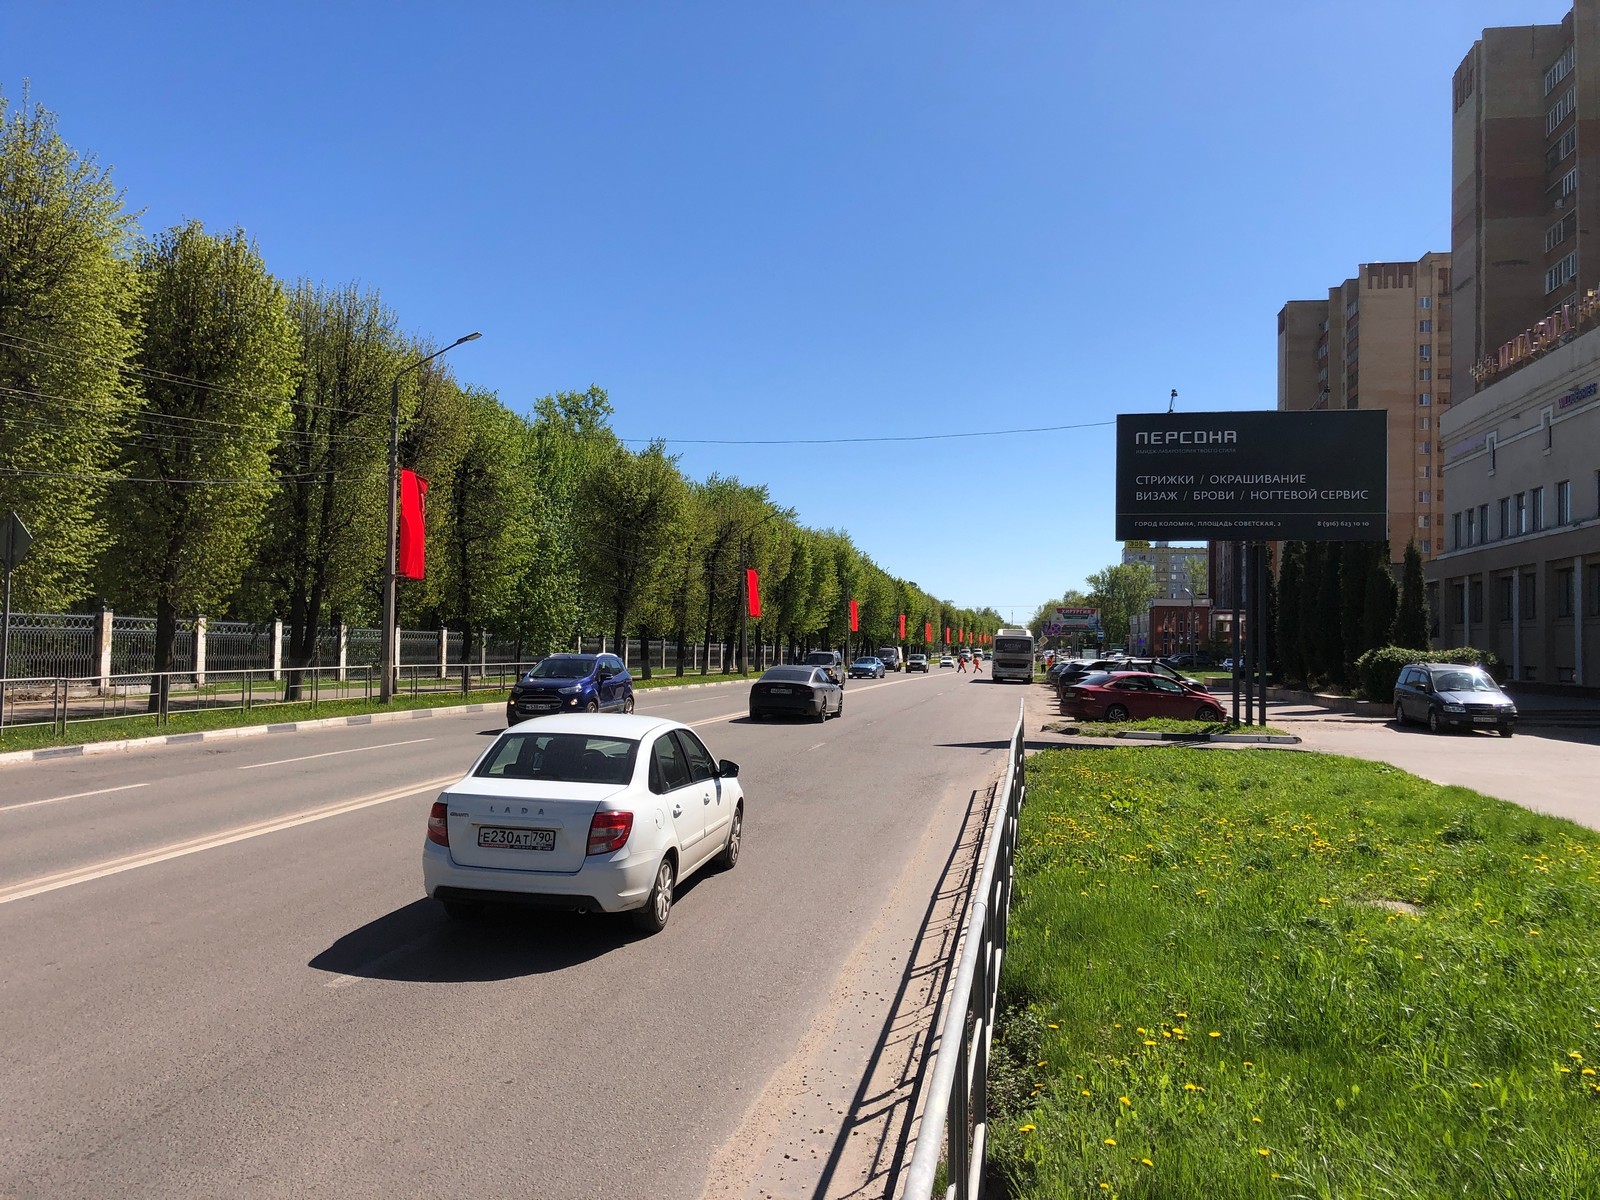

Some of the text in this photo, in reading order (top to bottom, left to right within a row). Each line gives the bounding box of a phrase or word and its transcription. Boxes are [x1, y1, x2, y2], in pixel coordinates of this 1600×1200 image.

[1135, 430, 1237, 445] ПЕРСОНА
[1135, 475, 1194, 485] СТРИЖКИ
[1209, 474, 1306, 485] ОКРАШИВАНИЕ
[1136, 491, 1178, 501] ВИЗАЖ
[1193, 490, 1235, 500] БРОВИ
[1250, 488, 1317, 500] НОГТЕВОЙ
[1320, 489, 1369, 500] СЕРВИС
[490, 806, 544, 816] LADA
